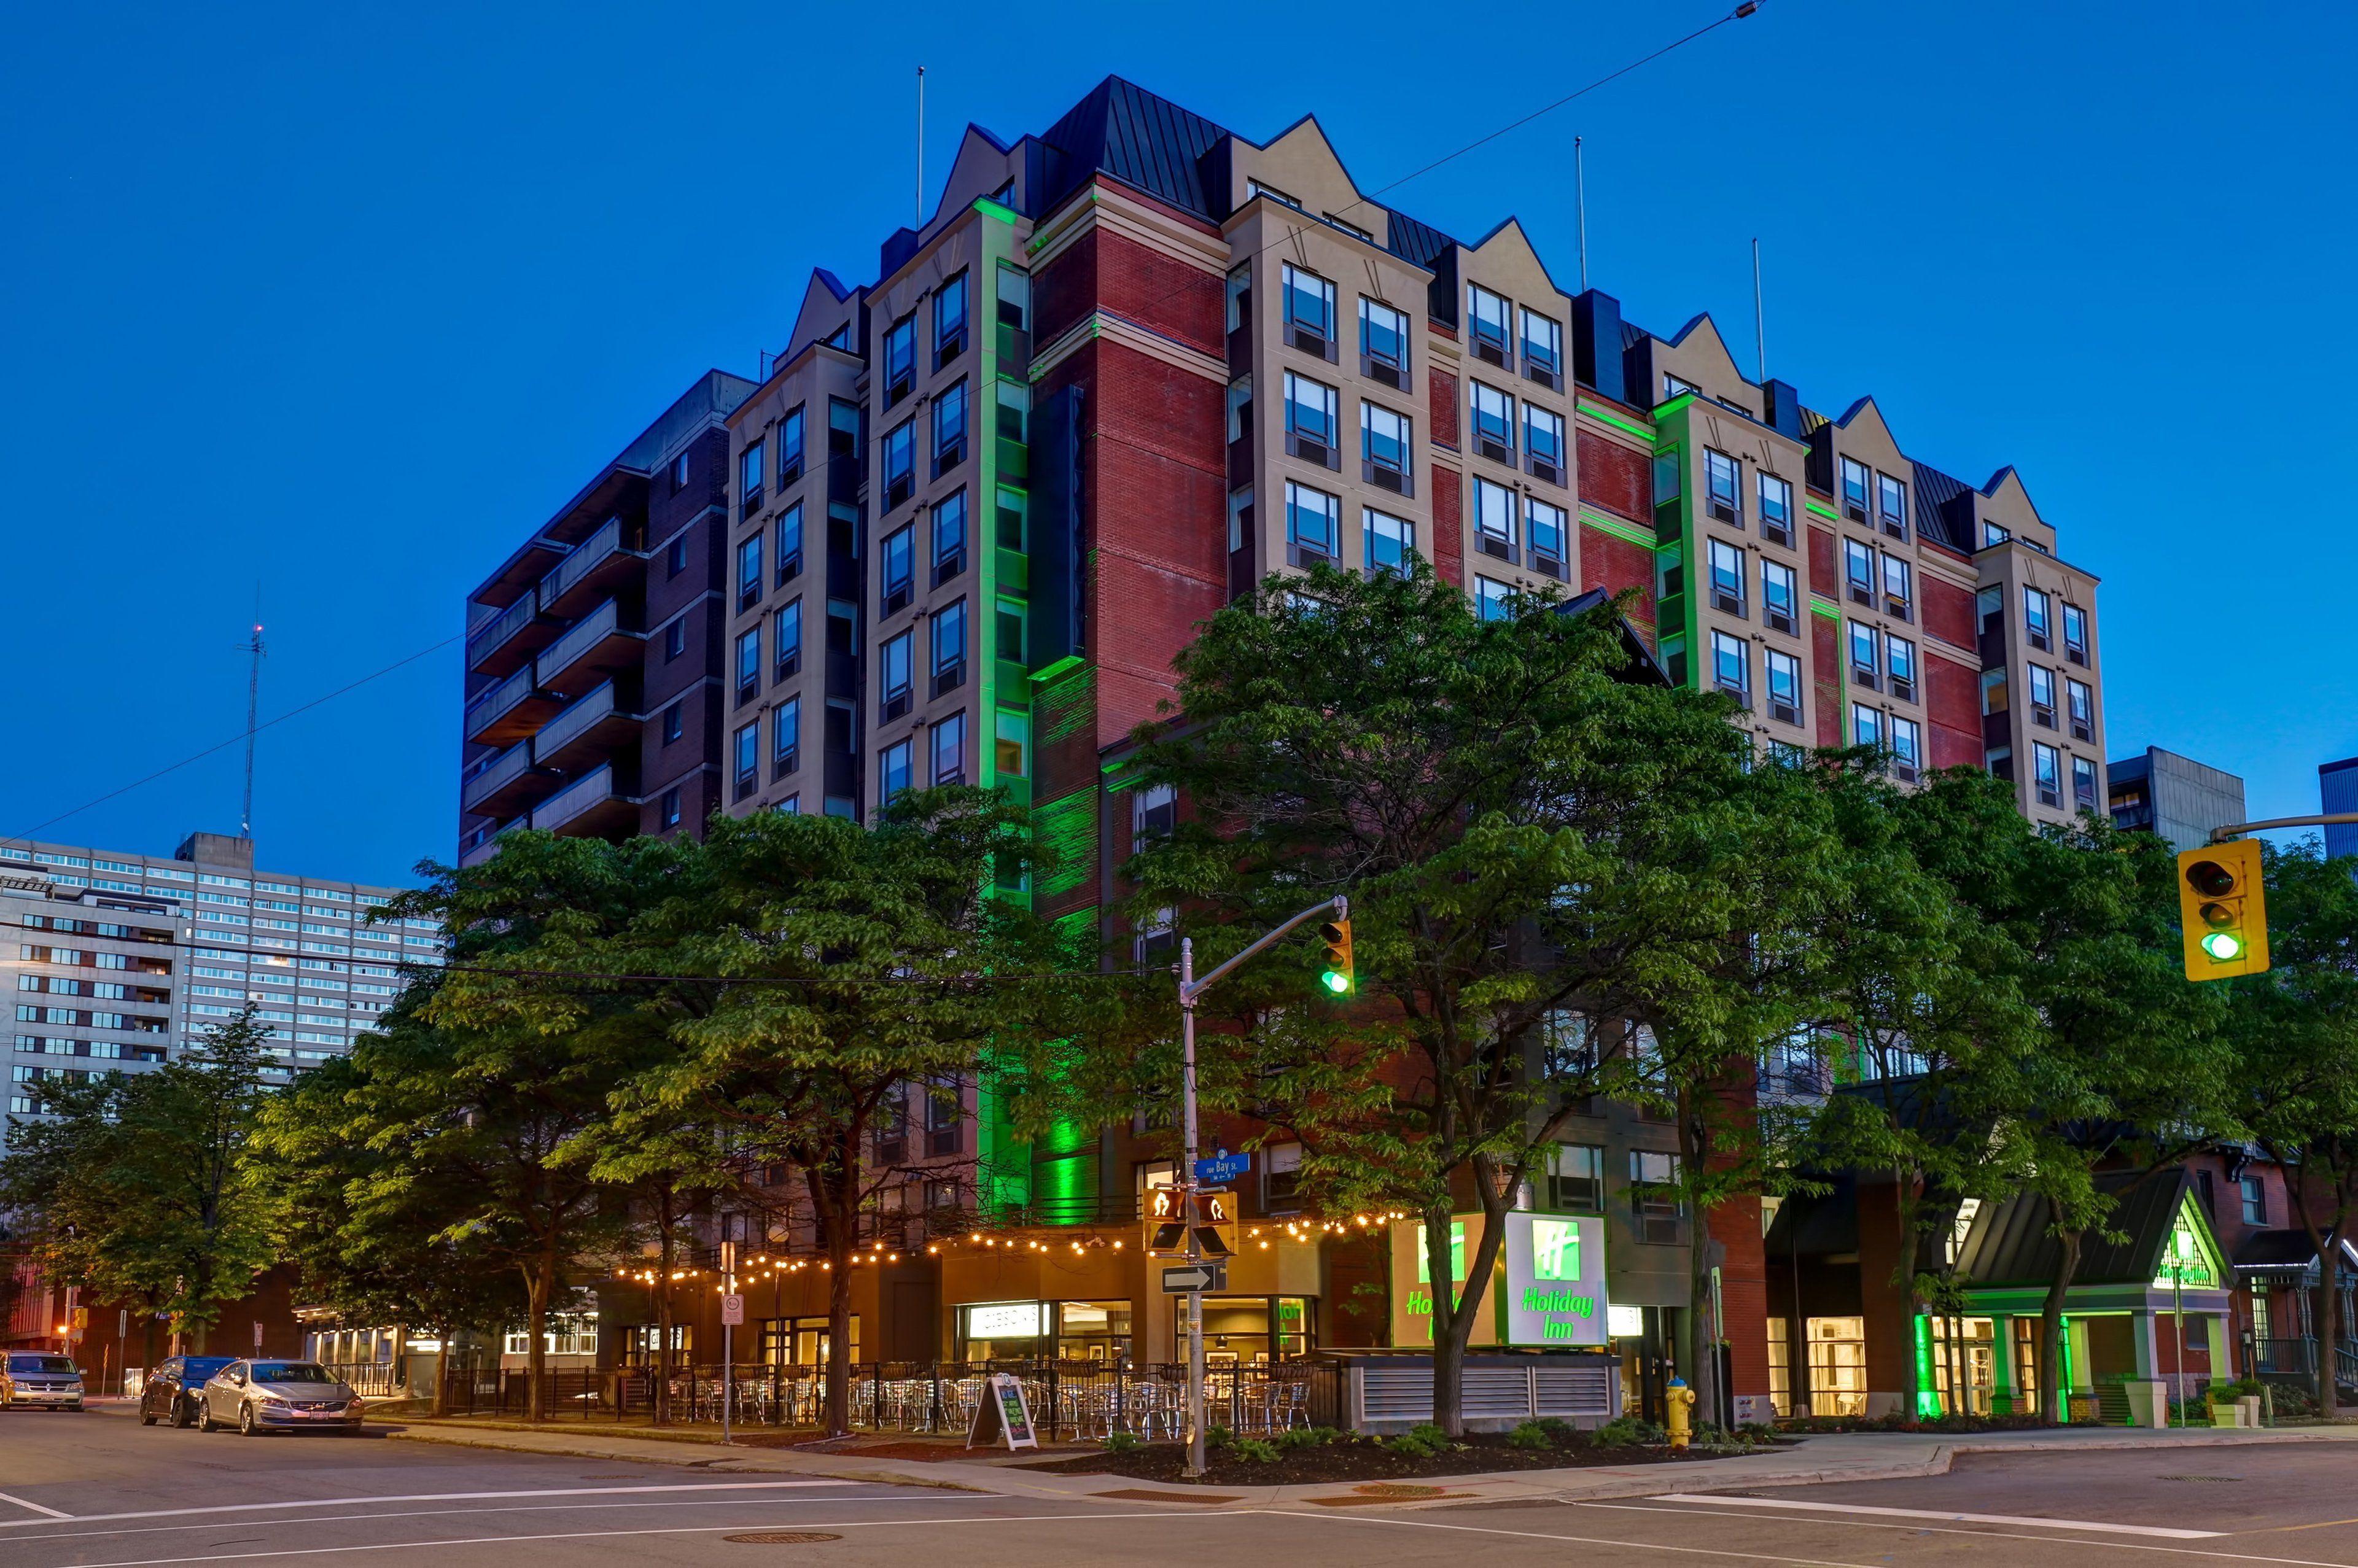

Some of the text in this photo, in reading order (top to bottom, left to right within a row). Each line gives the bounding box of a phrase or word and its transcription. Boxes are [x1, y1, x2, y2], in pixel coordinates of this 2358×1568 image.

[1216, 1161, 1229, 1174] Bay
[2195, 1265, 2209, 1280] Inn
[1522, 1287, 1594, 1319] Holiday
[1543, 1314, 1573, 1339] Inn
